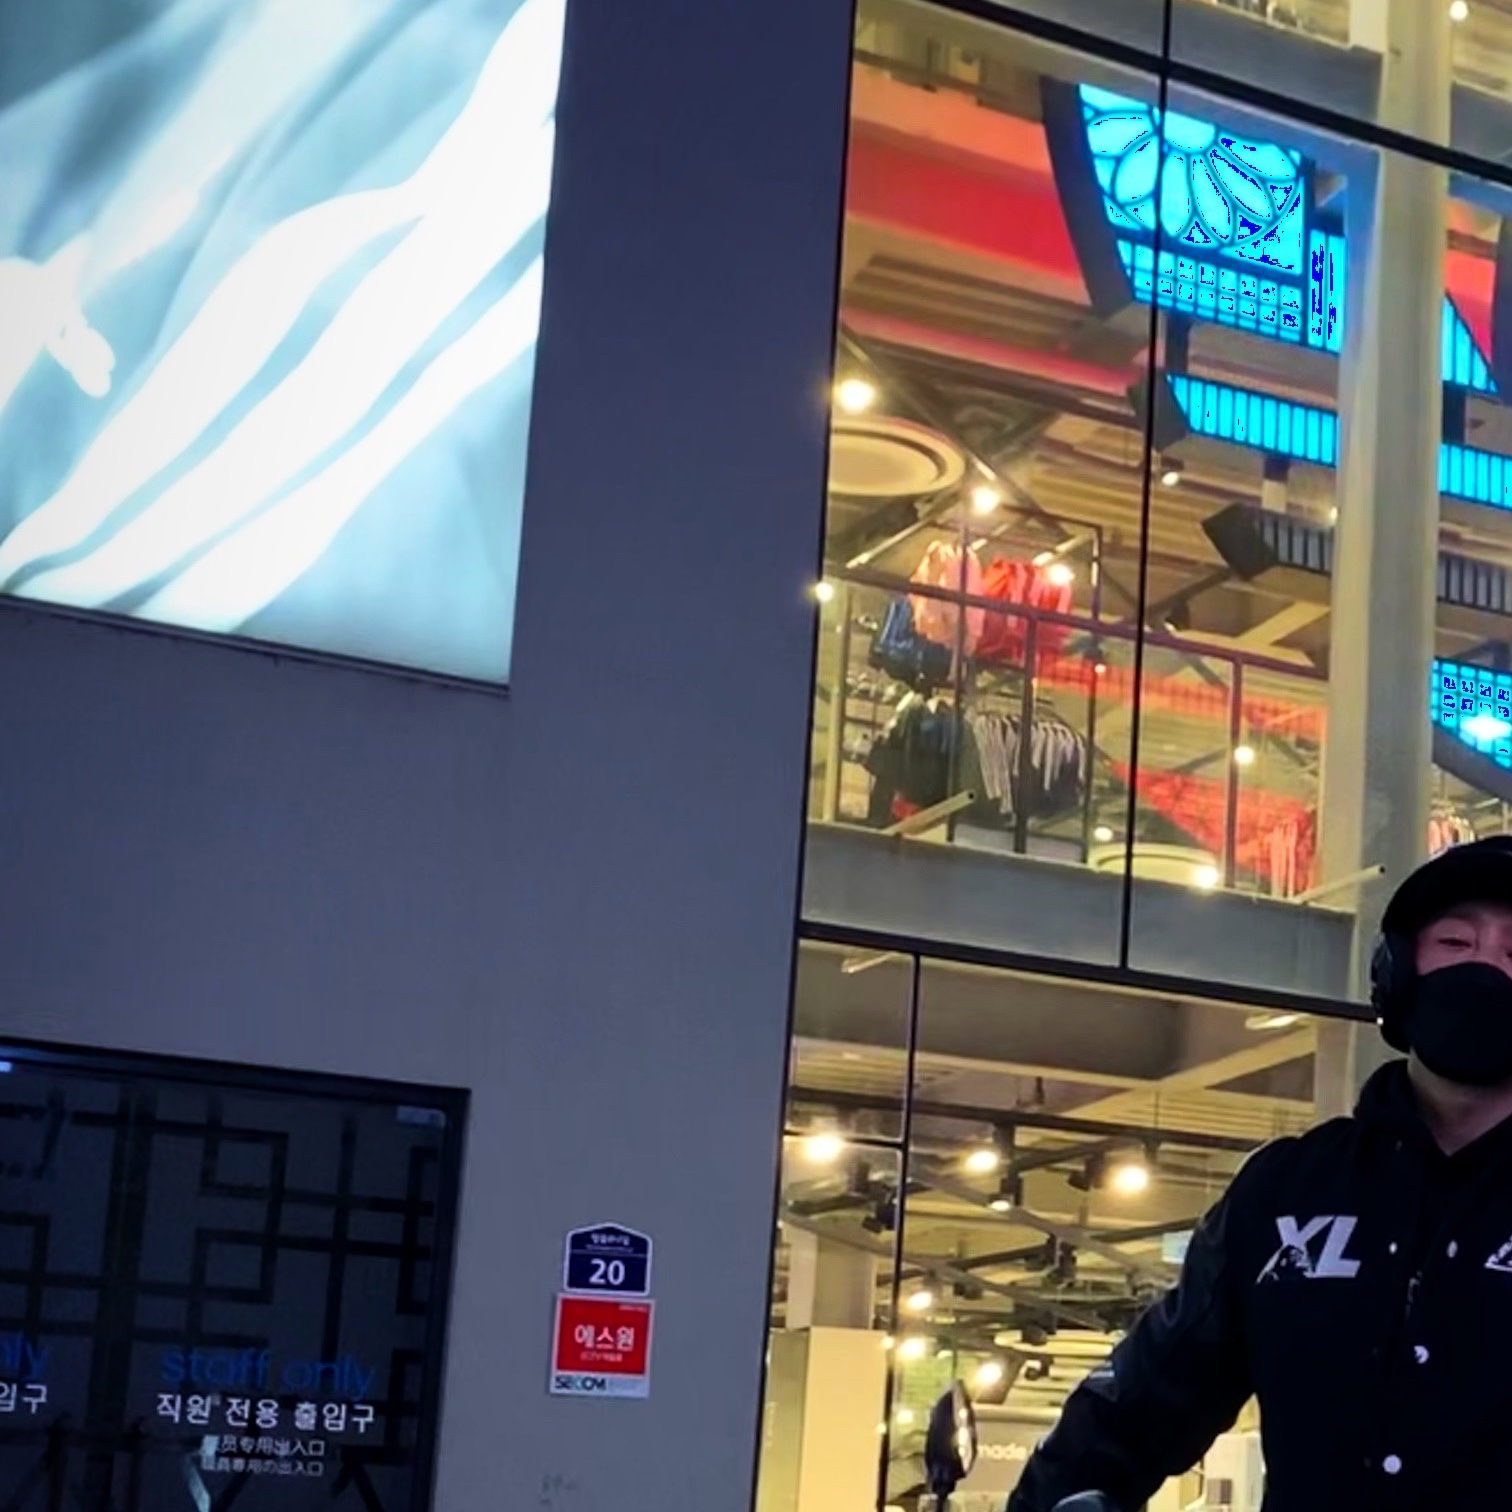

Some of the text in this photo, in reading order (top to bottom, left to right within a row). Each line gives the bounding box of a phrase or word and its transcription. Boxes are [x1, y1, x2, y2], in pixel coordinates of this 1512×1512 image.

[1257, 1215, 1361, 1284] XL
[589, 1258, 625, 1285] 20
[574, 1324, 635, 1352] 에스원
[161, 1349, 377, 1402] staff only
[156, 1394, 375, 1433] 직원 전용 출입구
